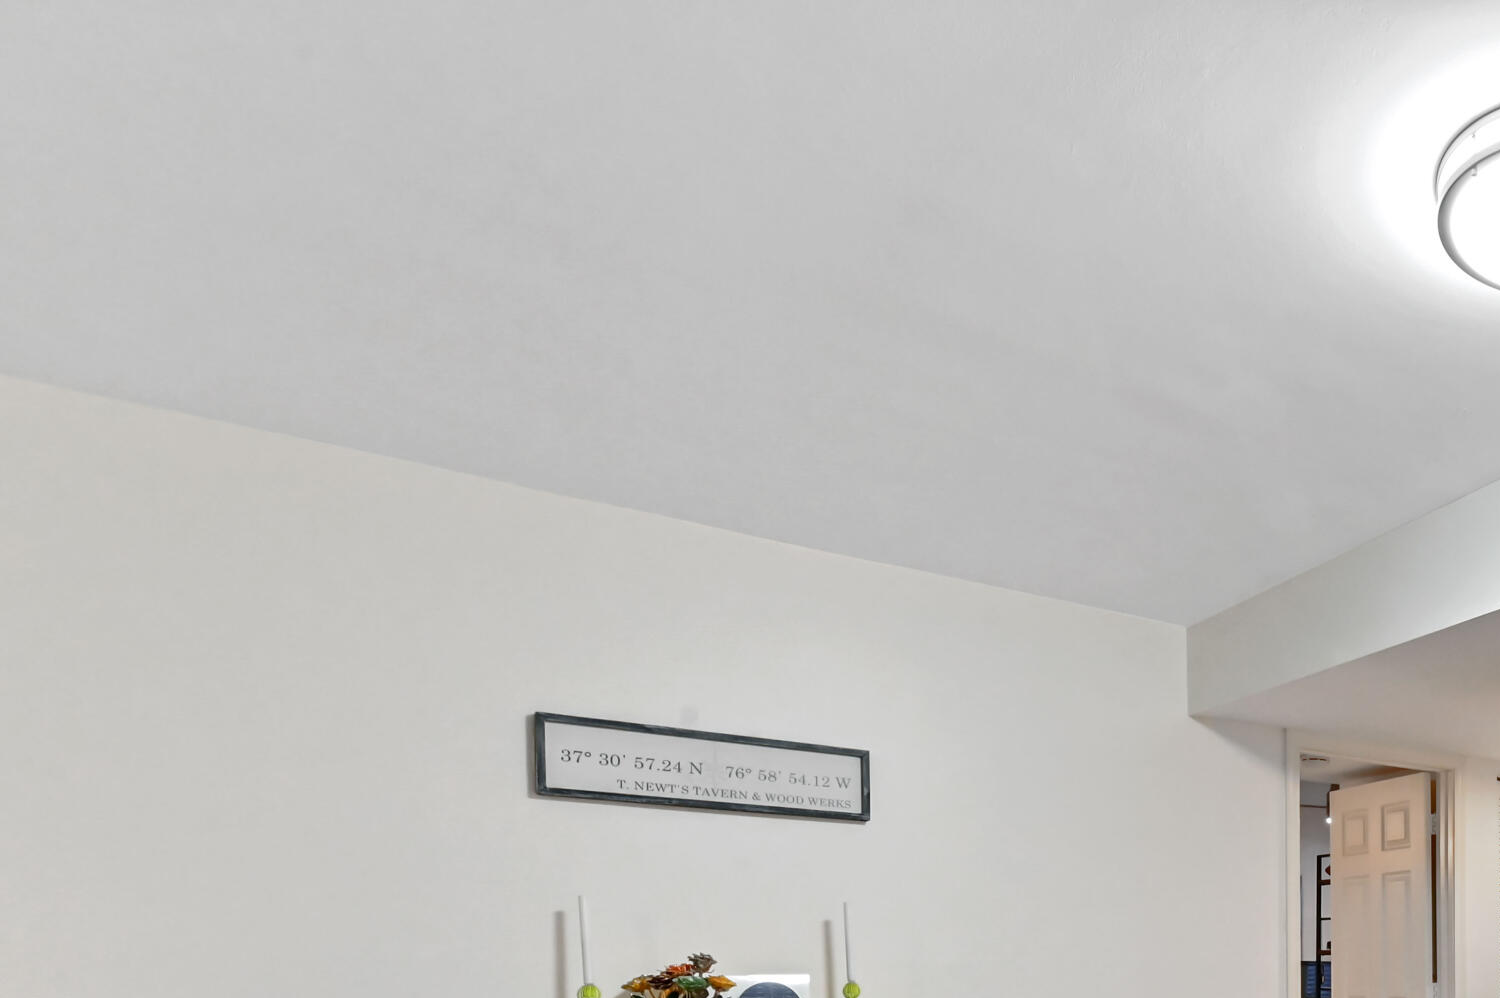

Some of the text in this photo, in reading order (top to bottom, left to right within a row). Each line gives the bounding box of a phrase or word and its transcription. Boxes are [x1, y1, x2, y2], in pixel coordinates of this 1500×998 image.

[634, 756, 682, 774] 57.24
[689, 761, 704, 775] N
[788, 772, 830, 788] 54.12
[836, 776, 852, 789] W
[616, 778, 852, 809] T. NEWT'S TAVERN & WOOD WERKS
